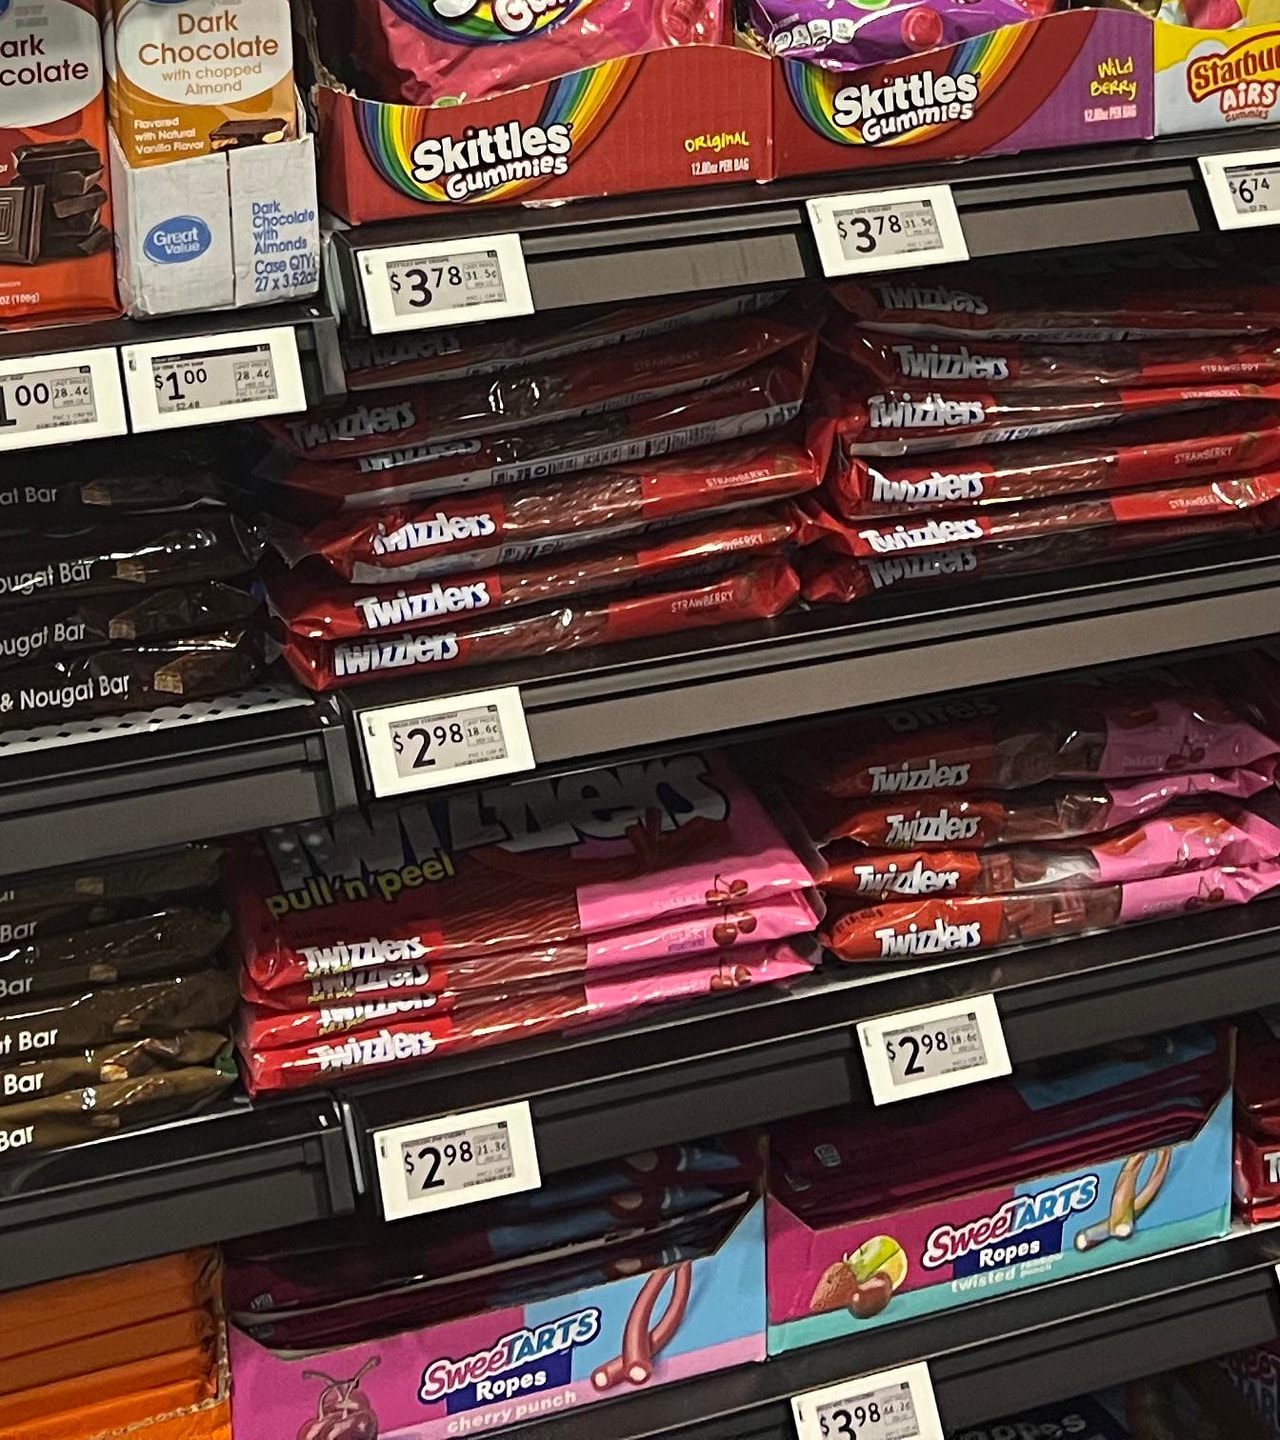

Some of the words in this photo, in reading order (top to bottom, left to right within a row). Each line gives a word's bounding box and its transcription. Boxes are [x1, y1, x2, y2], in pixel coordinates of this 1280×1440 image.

[139, 37, 279, 66] Chocolate
[162, 69, 190, 81] with
[196, 62, 262, 82] chopped
[185, 80, 242, 96] Almond
[834, 71, 978, 126] Skittles
[412, 122, 571, 183] Skittles
[446, 152, 568, 202] Gummies
[356, 580, 490, 628] Twizzlers
[671, 590, 734, 612] STRAWBERRY
[0, 695, 14, 712] &
[21, 681, 94, 709] Nougat
[99, 673, 129, 698] Bar
[874, 918, 980, 958] Twizzlers
[476, 1368, 547, 1399] Ropes
